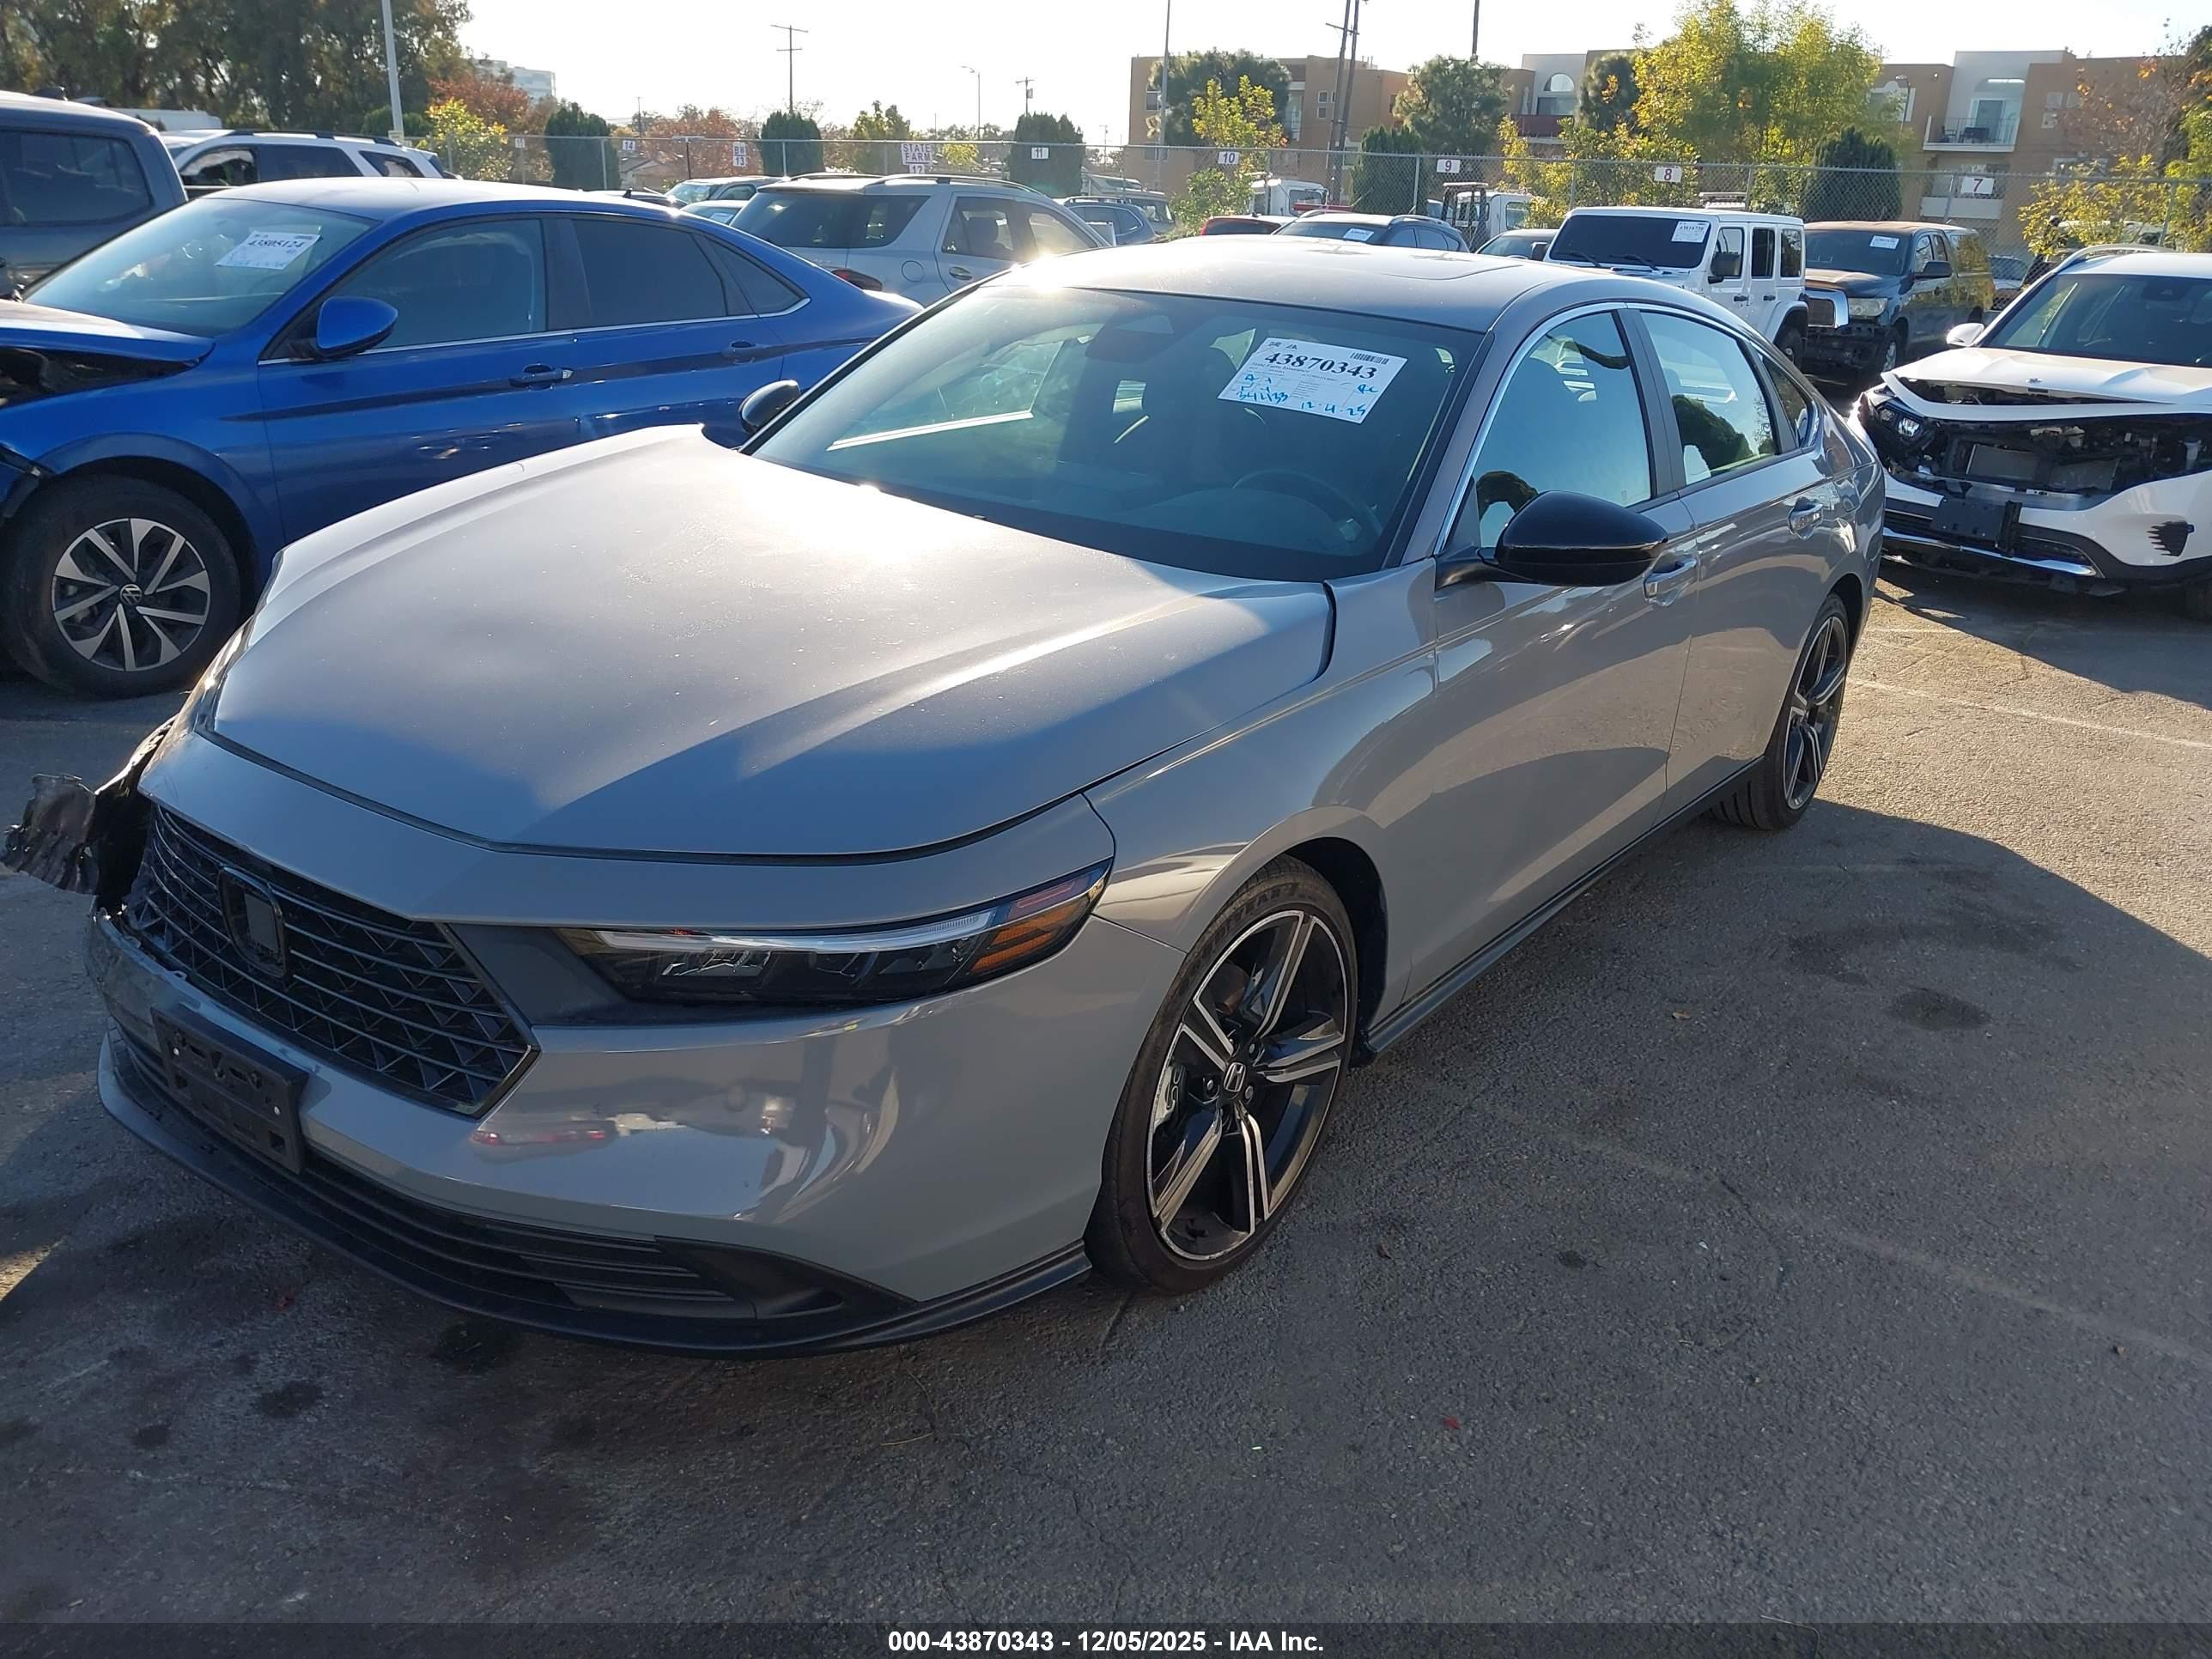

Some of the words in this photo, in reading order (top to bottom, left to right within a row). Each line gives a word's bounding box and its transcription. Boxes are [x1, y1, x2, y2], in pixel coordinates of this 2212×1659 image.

[902, 143, 931, 153] STATE
[1035, 148, 1043, 159] 11
[736, 156, 744, 165] 13
[905, 152, 931, 161] FARM
[1223, 152, 1236, 163] 10
[913, 165, 922, 173] 12
[1444, 160, 1452, 172] 9
[1663, 167, 1673, 180] 8
[1973, 178, 1984, 192] 7
[1264, 353, 1378, 380] 43870343
